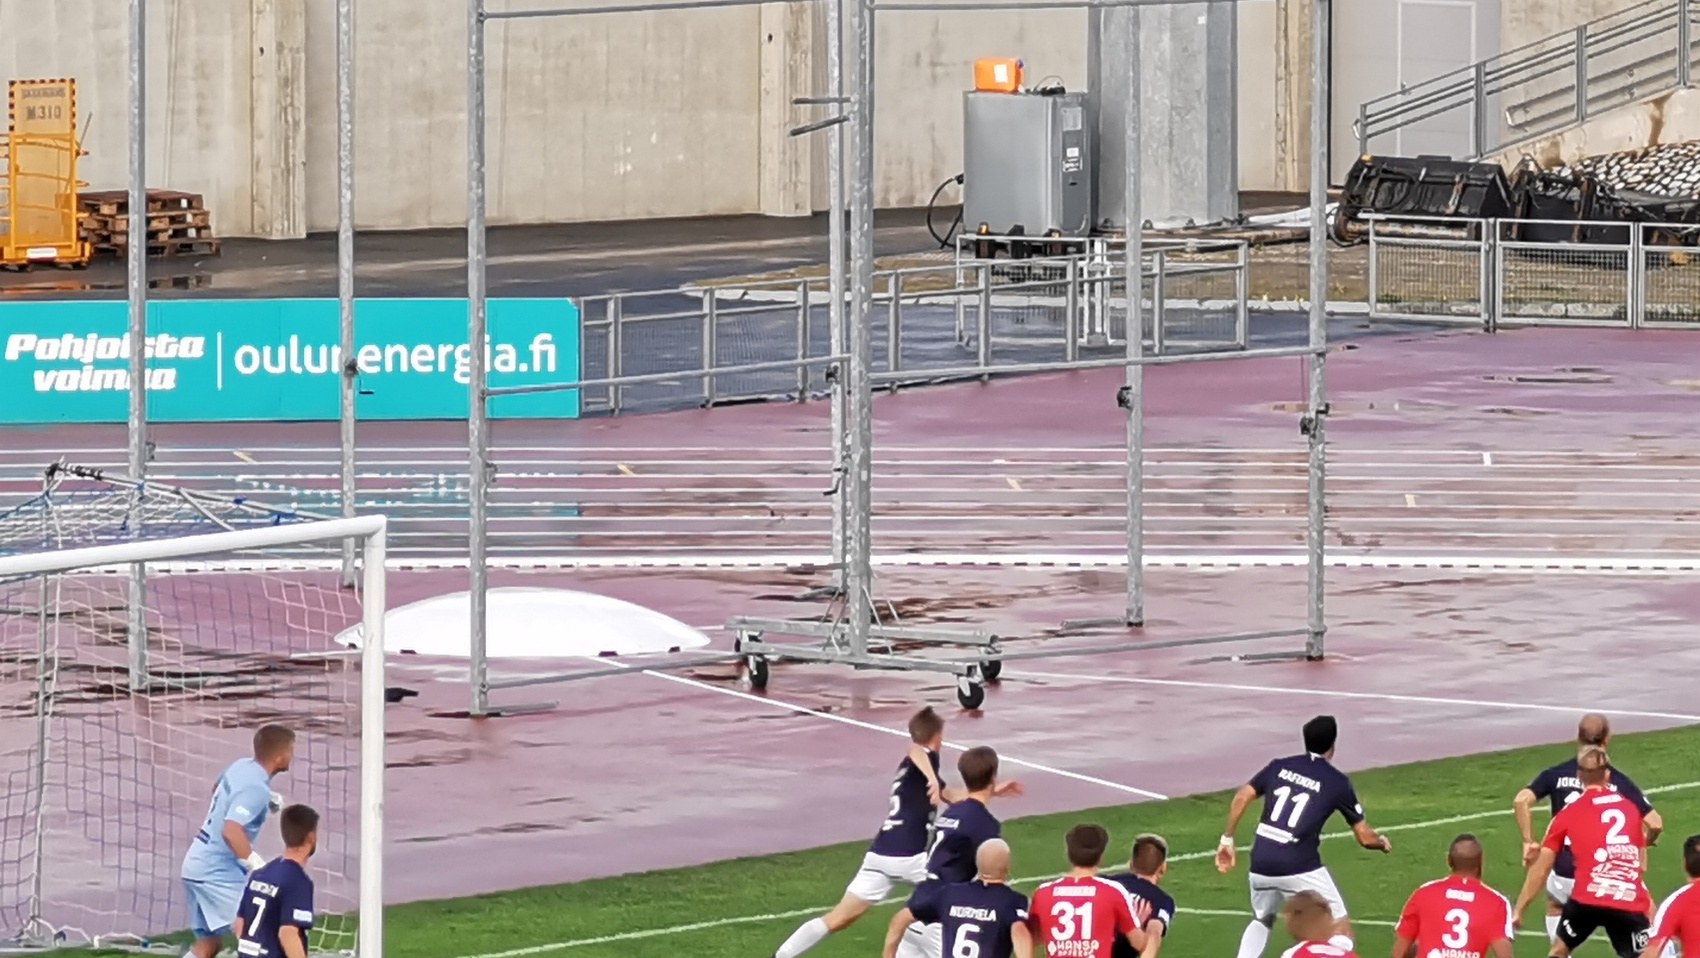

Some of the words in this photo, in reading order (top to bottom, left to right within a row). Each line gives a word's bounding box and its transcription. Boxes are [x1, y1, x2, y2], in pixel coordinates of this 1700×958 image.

[1270, 786, 1310, 828] 11
[1601, 808, 1631, 845] 2
[248, 897, 267, 937] 7
[1050, 901, 1093, 941] 31
[1441, 908, 1470, 949] 3
